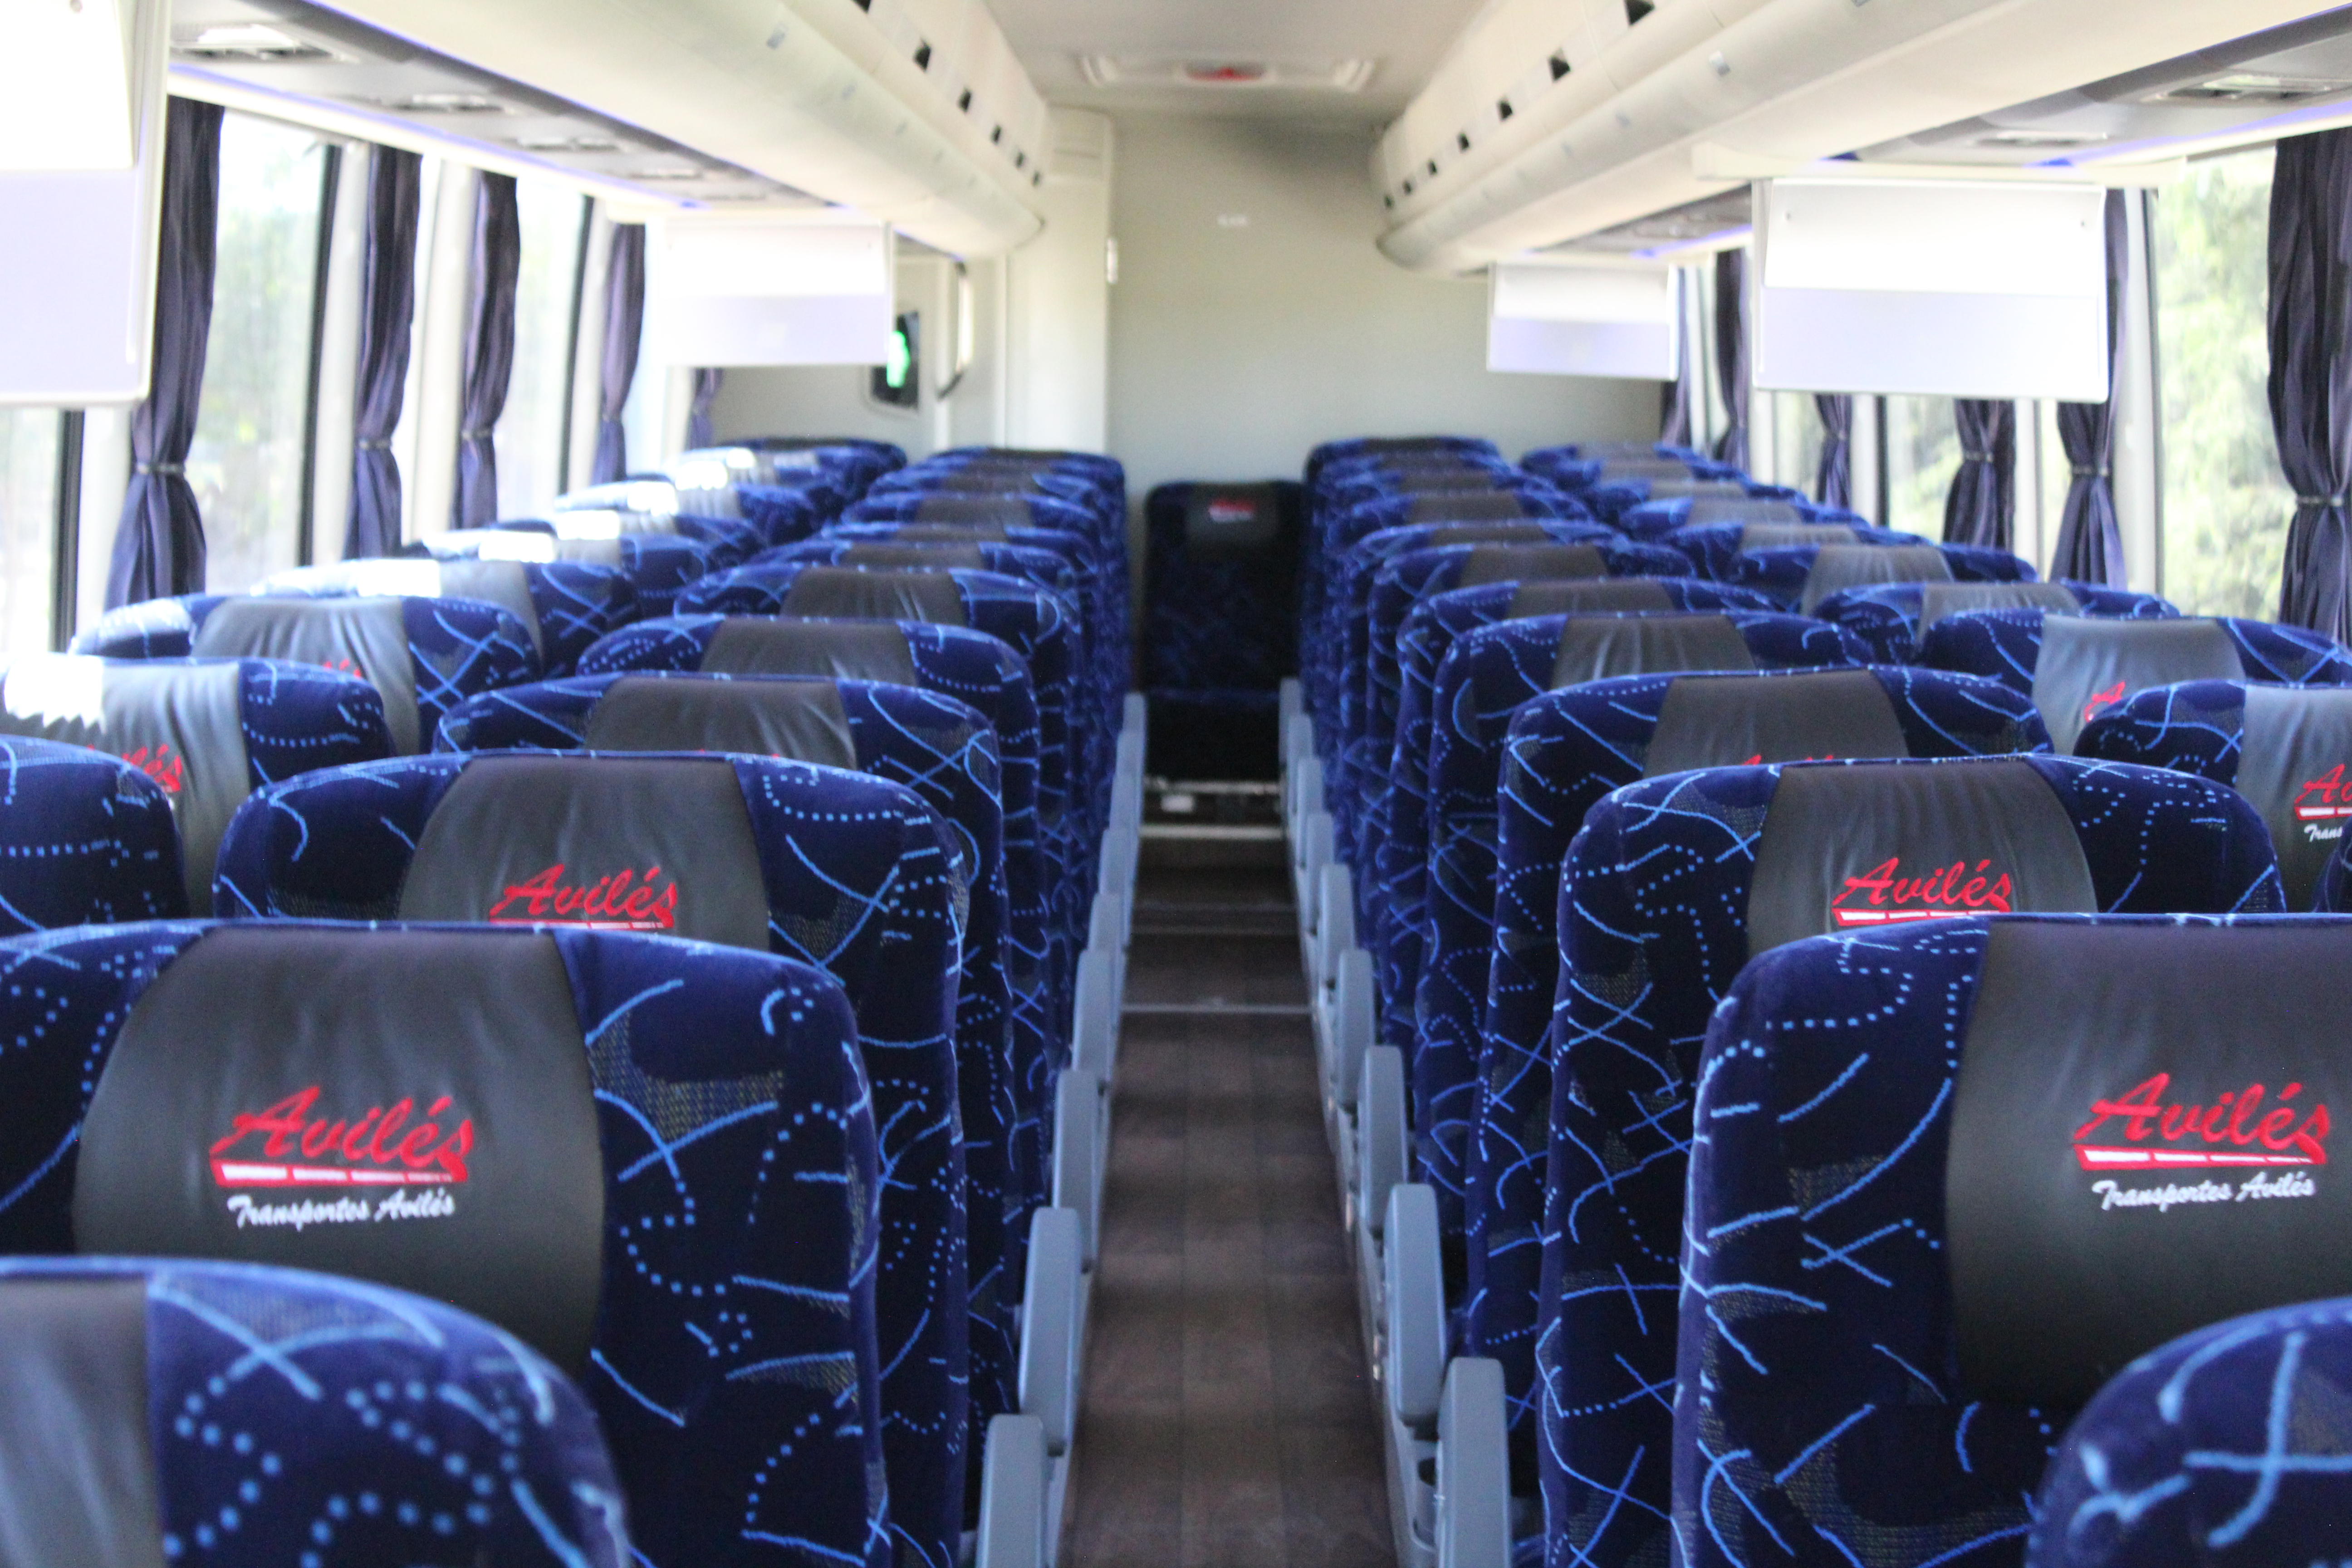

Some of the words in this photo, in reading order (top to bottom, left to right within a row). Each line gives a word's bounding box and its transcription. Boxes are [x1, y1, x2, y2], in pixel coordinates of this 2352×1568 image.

[489, 863, 677, 927] Avilés
[1831, 857, 2012, 912] Avilés
[209, 1085, 474, 1182] Avilés
[2073, 1072, 2330, 1165] Avilés
[227, 1195, 371, 1232] Transportes
[2091, 1180, 2233, 1213] Transportes
[2235, 1171, 2315, 1202] Avilés
